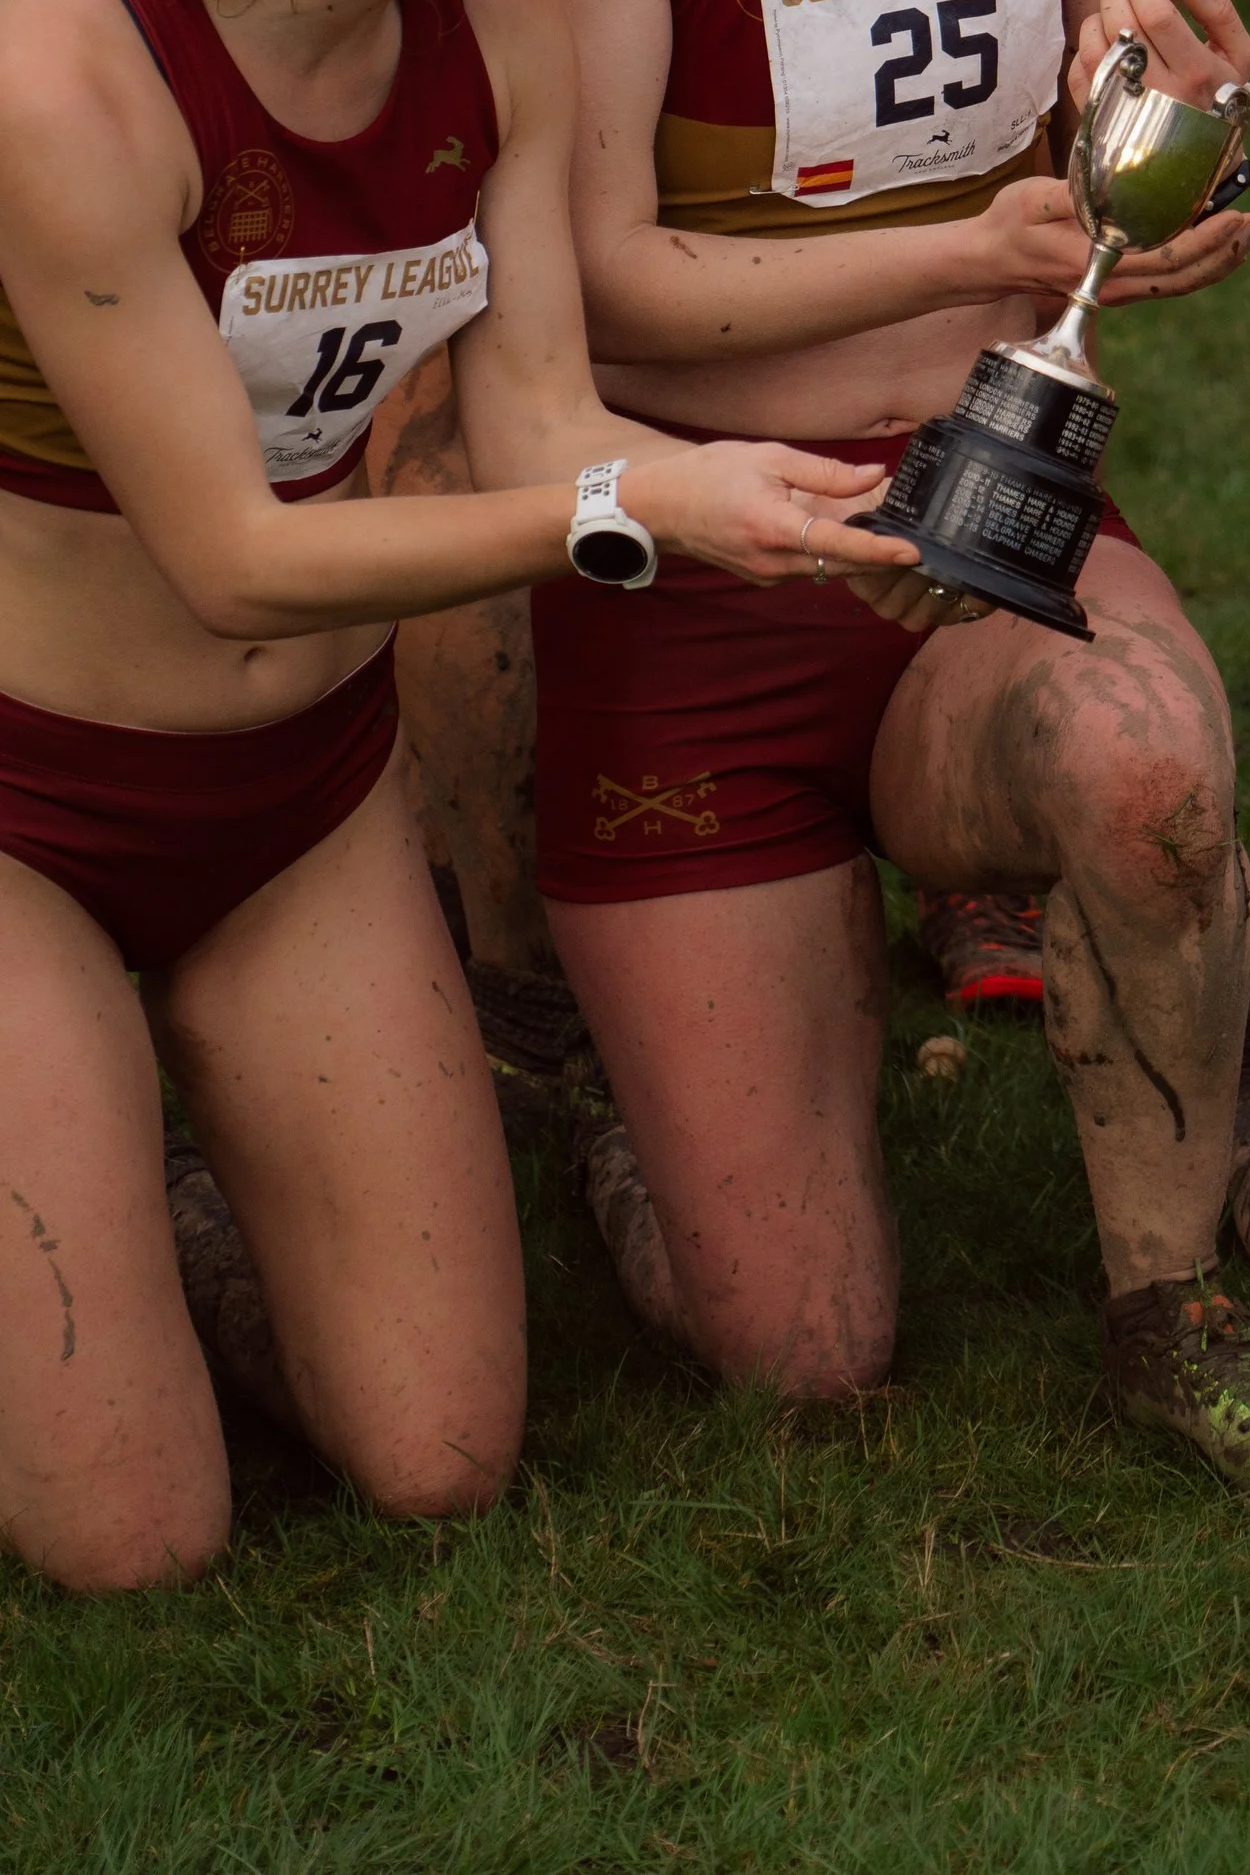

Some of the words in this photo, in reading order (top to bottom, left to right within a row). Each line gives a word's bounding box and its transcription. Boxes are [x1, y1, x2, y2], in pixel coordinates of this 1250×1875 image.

[892, 139, 976, 173] Tracksmith
[242, 265, 373, 316] SURREY
[381, 234, 480, 300] LEAGUE
[285, 320, 403, 417] 16
[974, 389, 999, 404] LONDON
[998, 399, 1037, 420] HARRIERS
[978, 381, 1003, 397] LONDON
[1002, 392, 1040, 413] HARRIERS
[964, 410, 988, 425] LONDON
[987, 420, 1025, 441] HARRIERS
[968, 402, 992, 417] LONDON
[991, 413, 1029, 434] HARRIERS
[971, 396, 995, 411] LONDON
[995, 406, 1033, 428] HARRIERS
[991, 490, 1022, 509] THAMES
[1022, 504, 1042, 518] HARE
[994, 483, 1025, 501] THAMES
[1026, 496, 1047, 510] HARE
[987, 499, 1018, 517] THAMES
[1019, 512, 1039, 526] HARE
[988, 509, 1031, 533] BELGRAVE
[981, 528, 1022, 550] CLAPHAM
[642, 775, 658, 790] B
[610, 799, 628, 811] 18
[672, 794, 695, 807] 87
[644, 820, 662, 835] H
